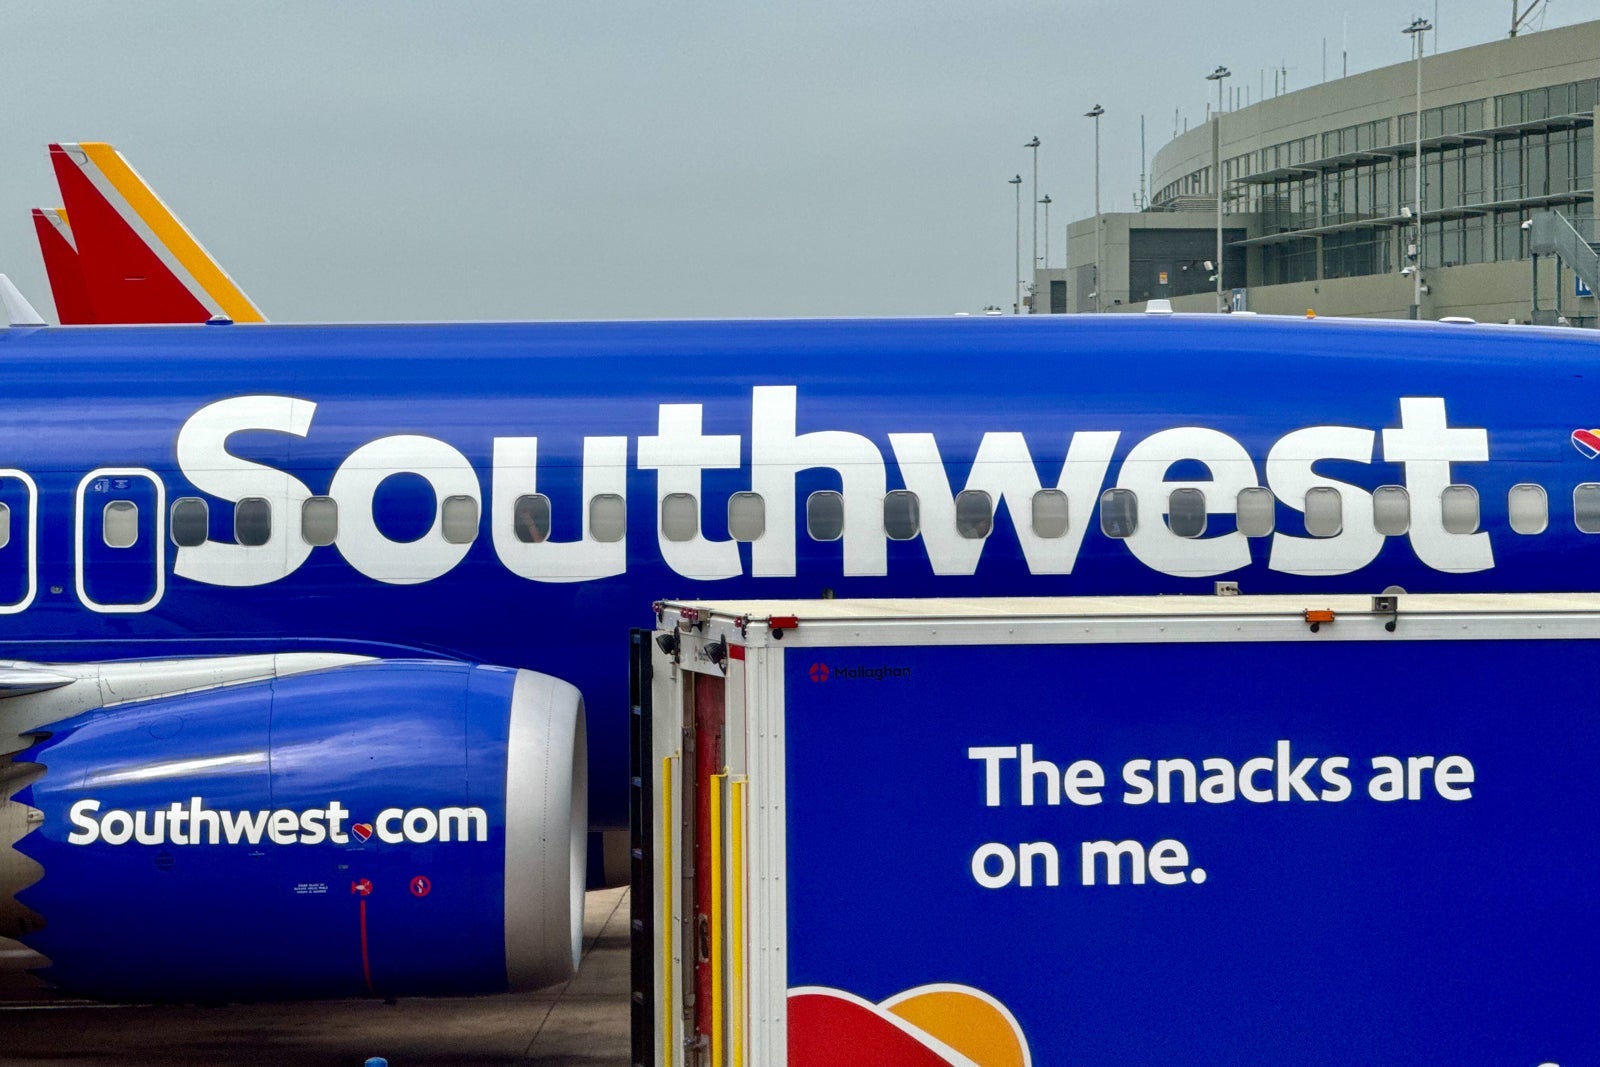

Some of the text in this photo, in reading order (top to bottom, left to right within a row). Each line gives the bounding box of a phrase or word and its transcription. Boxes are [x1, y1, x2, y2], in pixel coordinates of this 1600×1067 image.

[171, 385, 1495, 588] Southwest
[834, 665, 911, 681] Mallaghan
[968, 740, 1475, 807] The snacks are
[971, 839, 1207, 889] on me.
